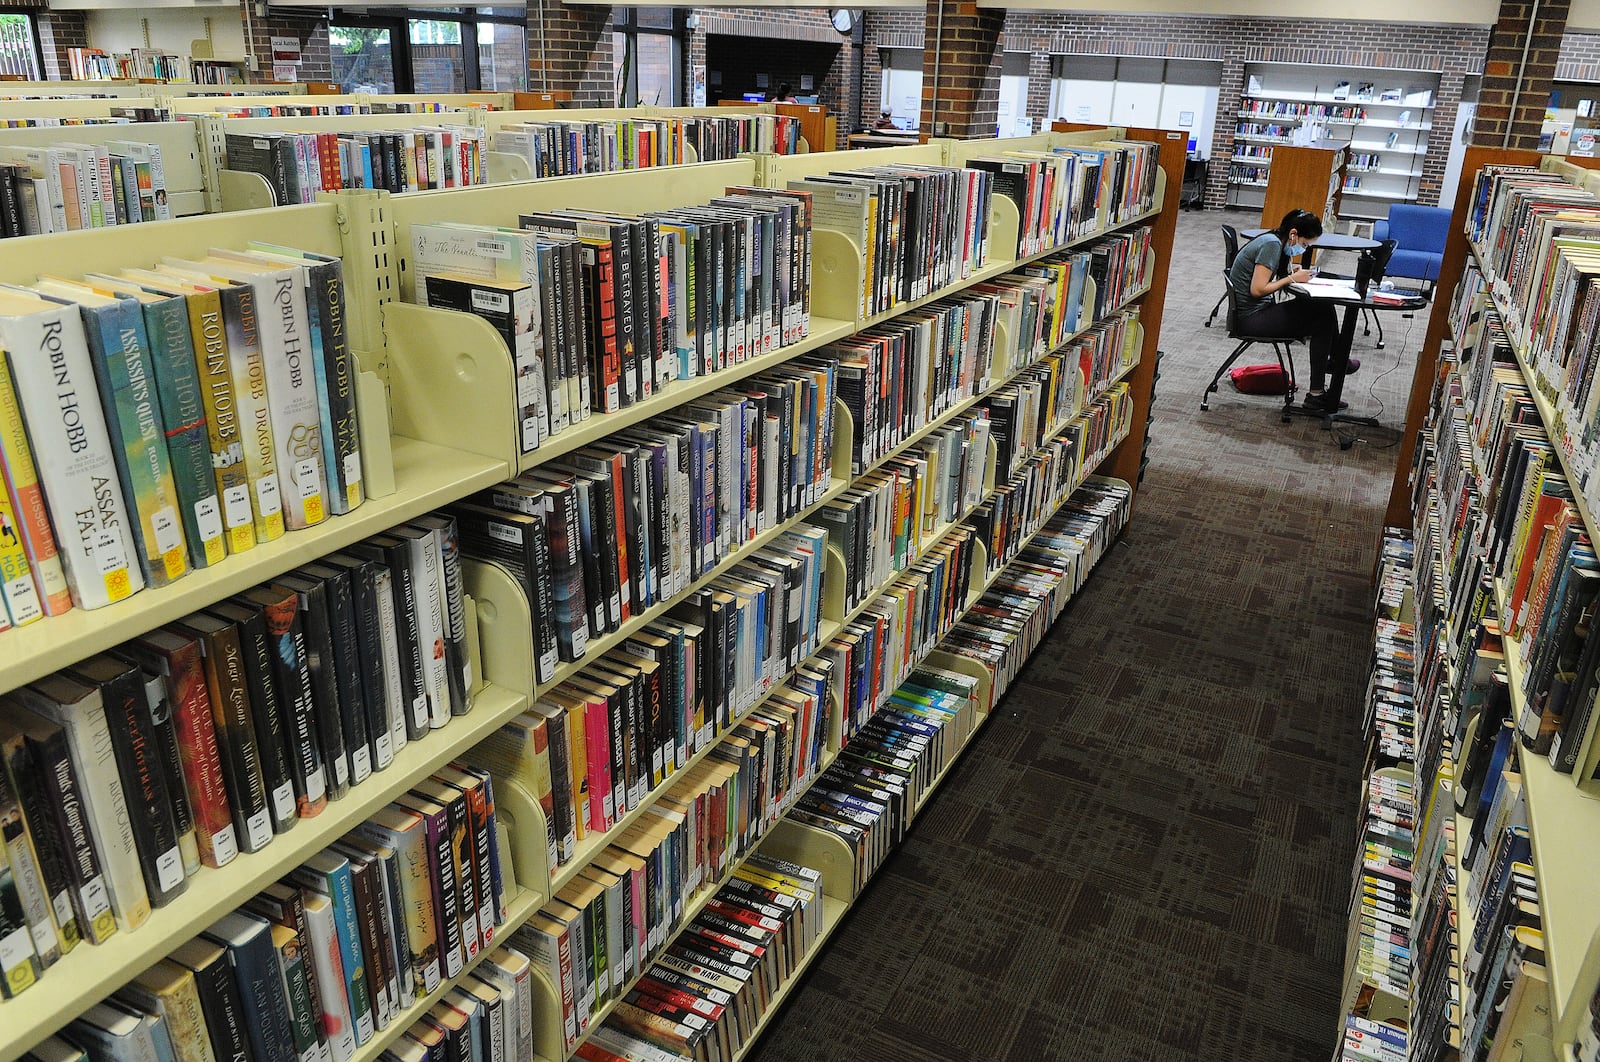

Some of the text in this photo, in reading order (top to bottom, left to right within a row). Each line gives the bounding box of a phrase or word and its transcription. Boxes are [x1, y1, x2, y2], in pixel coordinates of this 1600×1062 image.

[652, 223, 660, 258] DAVID
[273, 274, 296, 335] ROBIN
[555, 284, 562, 296] OF
[565, 259, 575, 331] THE HANGING
[619, 230, 632, 334] THE BETRAYED
[326, 277, 349, 400] ROBIN HOBB
[548, 286, 556, 338] FORGOTTEN
[556, 298, 564, 346] JEOPARDY
[40, 318, 70, 387] ROBIN
[58, 388, 89, 454] HOBB
[162, 307, 199, 432] ROBIN HOBB
[200, 311, 236, 440] ROBIN HOBB
[238, 290, 272, 467] ROBIN HOBB DRAGON
[283, 337, 303, 390] HOBB
[120, 326, 162, 484] ASSASSIN'S QUEST ROBIN
[632, 456, 640, 493] HOWARD
[1522, 456, 1544, 522] ETHAN HAWKE
[564, 495, 576, 566] AFTER SUNDOWN
[402, 568, 410, 582] so
[403, 584, 414, 611] much
[424, 543, 442, 632] LAST WITNESS
[445, 551, 465, 643] Retribution
[534, 533, 547, 618] CARTER LOVECRAFT
[404, 612, 416, 642] pretty
[254, 633, 280, 736] ALICE HOFFMAN
[294, 632, 314, 712] ALICE HOFFMAN
[650, 673, 660, 728] WOOL
[225, 643, 256, 772] Magic Lessons ALICE
[292, 696, 314, 774] THE STORY SISTERS
[628, 698, 636, 727] BEAUTY
[630, 726, 635, 734] OF
[123, 697, 154, 802] ALICE HOFFMAN
[188, 698, 214, 801] The Marriage of Opposites
[195, 683, 228, 807] ALICE HOFFMAN
[615, 735, 624, 768] DECEIT
[54, 758, 96, 880] Winds of Graystone Manor
[108, 780, 134, 856] ALICE HOFFMAN
[477, 830, 488, 852] ODD
[438, 840, 456, 918] BEYOND THE
[460, 860, 474, 912] NO ECHO
[728, 878, 752, 892] HUNTER
[296, 916, 307, 946] ARE YOU
[340, 875, 350, 895] Evvie
[351, 942, 360, 962] Over
[368, 918, 377, 949] HOLMES
[380, 906, 388, 934] HOLMES
[560, 942, 573, 1006] CITY SAINTS
[650, 966, 680, 984] HUNTER
[663, 954, 692, 972] HUNTER
[684, 950, 710, 964] STEPHEN
[253, 980, 268, 1008] ALAN
[290, 970, 310, 1038] WINGS GLASS
[492, 1008, 501, 1026] KAY
[519, 980, 531, 1034] KAY HOOPER
[224, 1006, 241, 1050] DROWNING
[459, 1030, 468, 1056] KAY
